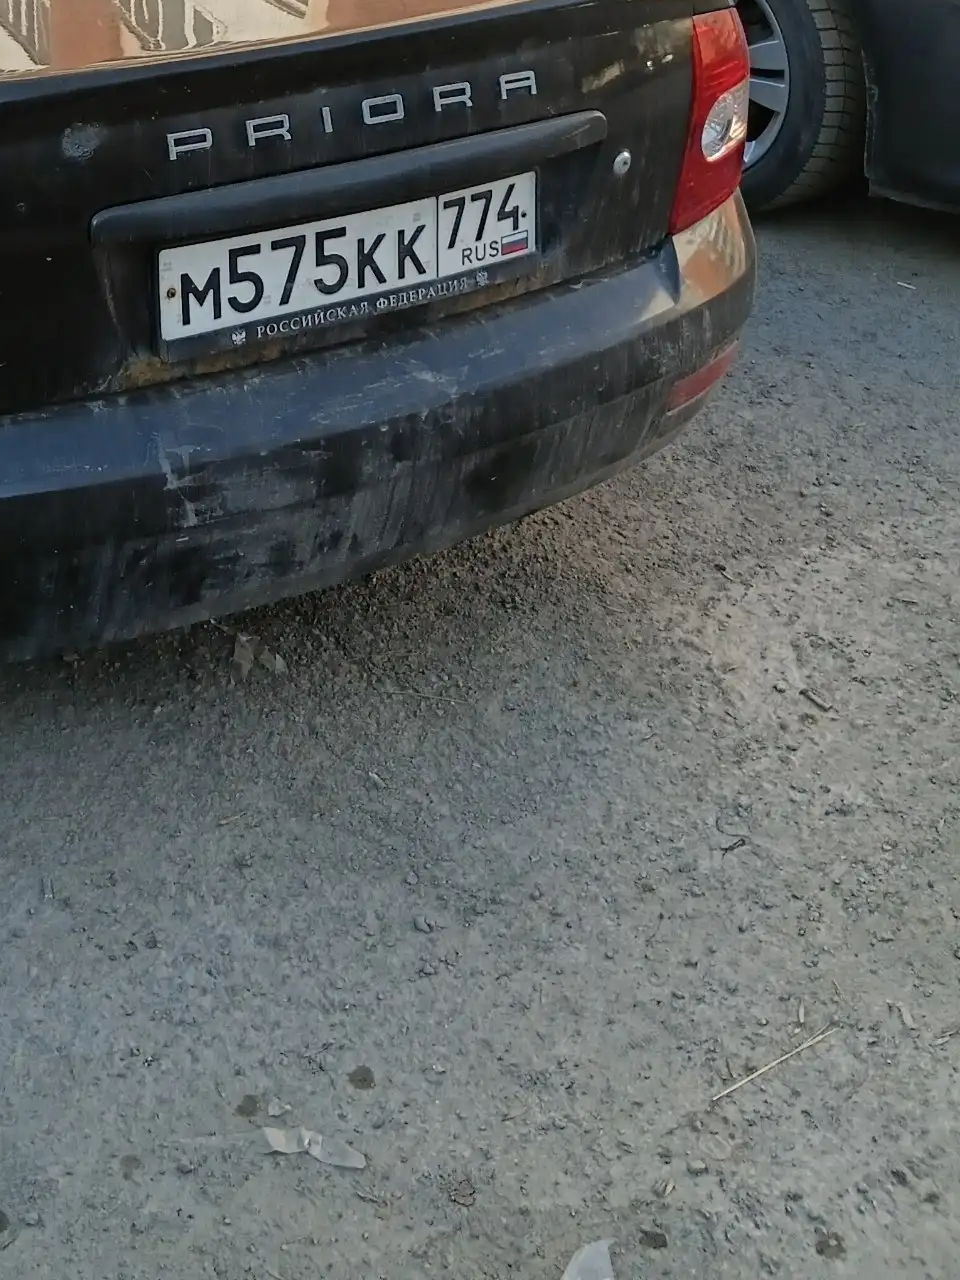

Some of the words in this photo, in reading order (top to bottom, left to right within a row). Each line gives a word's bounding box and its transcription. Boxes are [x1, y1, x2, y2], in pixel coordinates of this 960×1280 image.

[166, 69, 538, 161] PRIORA
[443, 183, 520, 250] 774
[461, 240, 500, 266] RUS
[256, 302, 370, 338] РОССИЙСКАЯ
[376, 276, 468, 310] ФЕДЕРАЦИЯ
